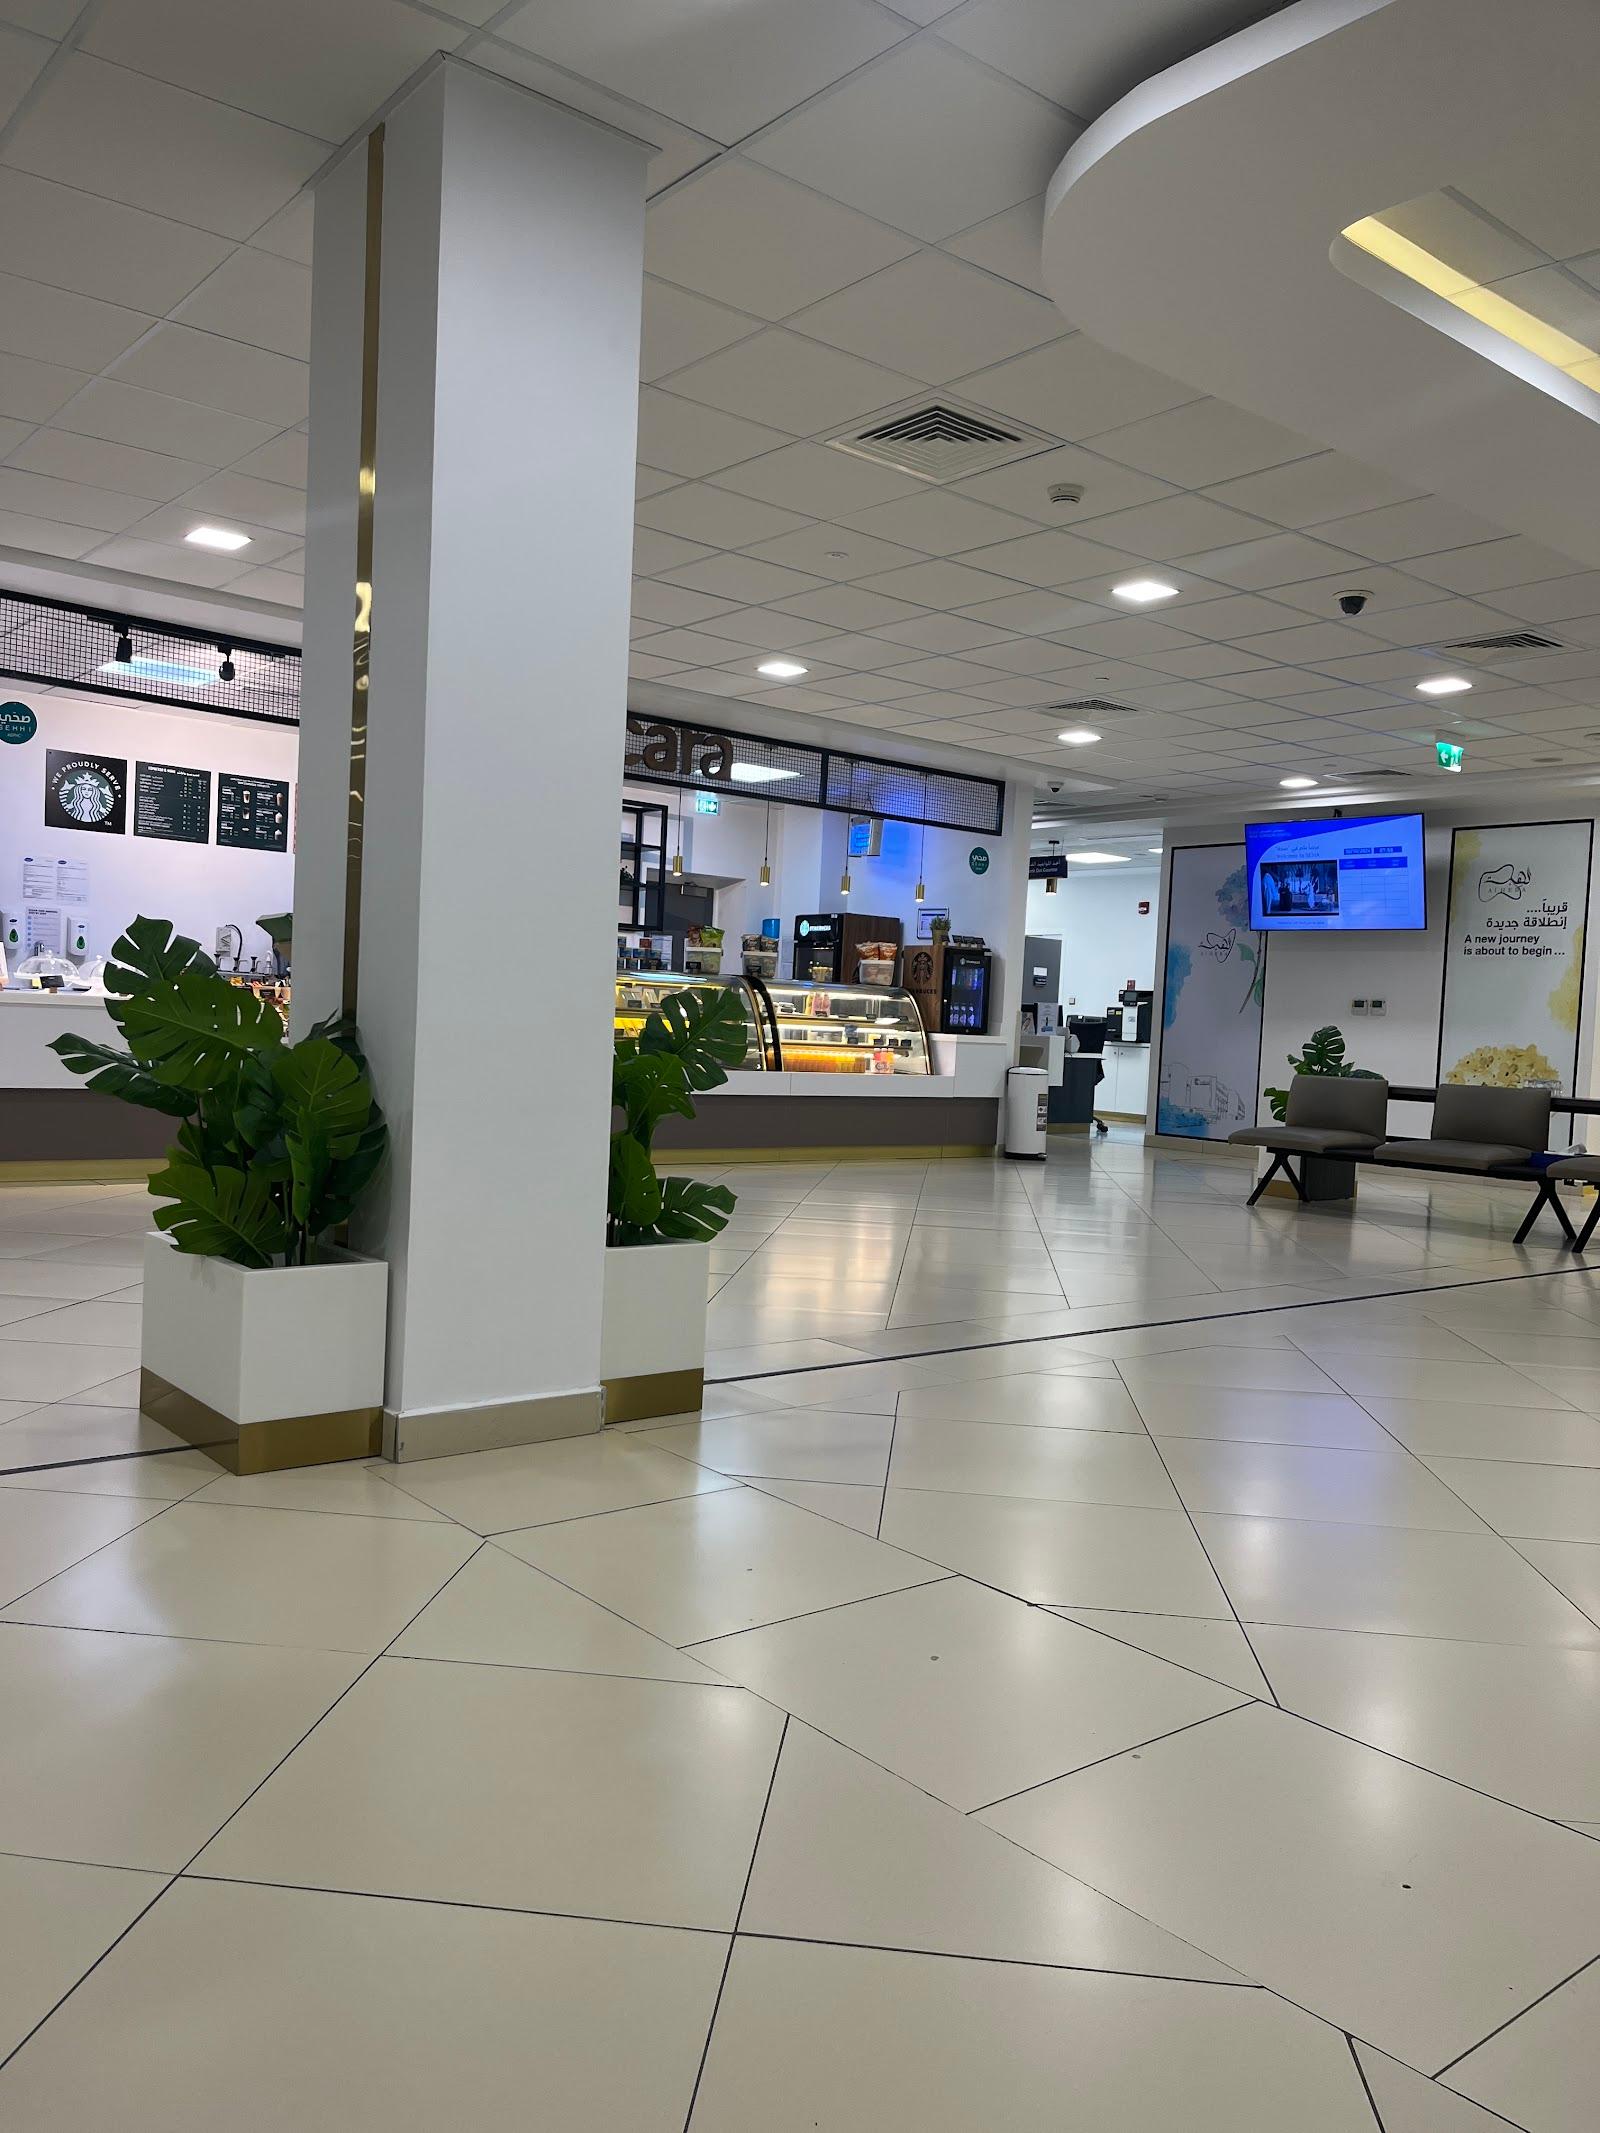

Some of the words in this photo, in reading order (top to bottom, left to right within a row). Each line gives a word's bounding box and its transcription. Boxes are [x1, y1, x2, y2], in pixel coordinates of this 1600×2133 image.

[51, 772, 62, 784] WE
[61, 761, 100, 773] PROUDLY
[100, 767, 121, 791] SERVE
[1486, 918, 1519, 931] جديدة
[1523, 916, 1567, 930] إنطلاقة
[1464, 934, 1472, 944] A
[1475, 935, 1497, 944] new
[1498, 934, 1540, 945] journey
[1463, 946, 1472, 956] is
[1475, 946, 1505, 956] about
[1508, 947, 1519, 956] to
